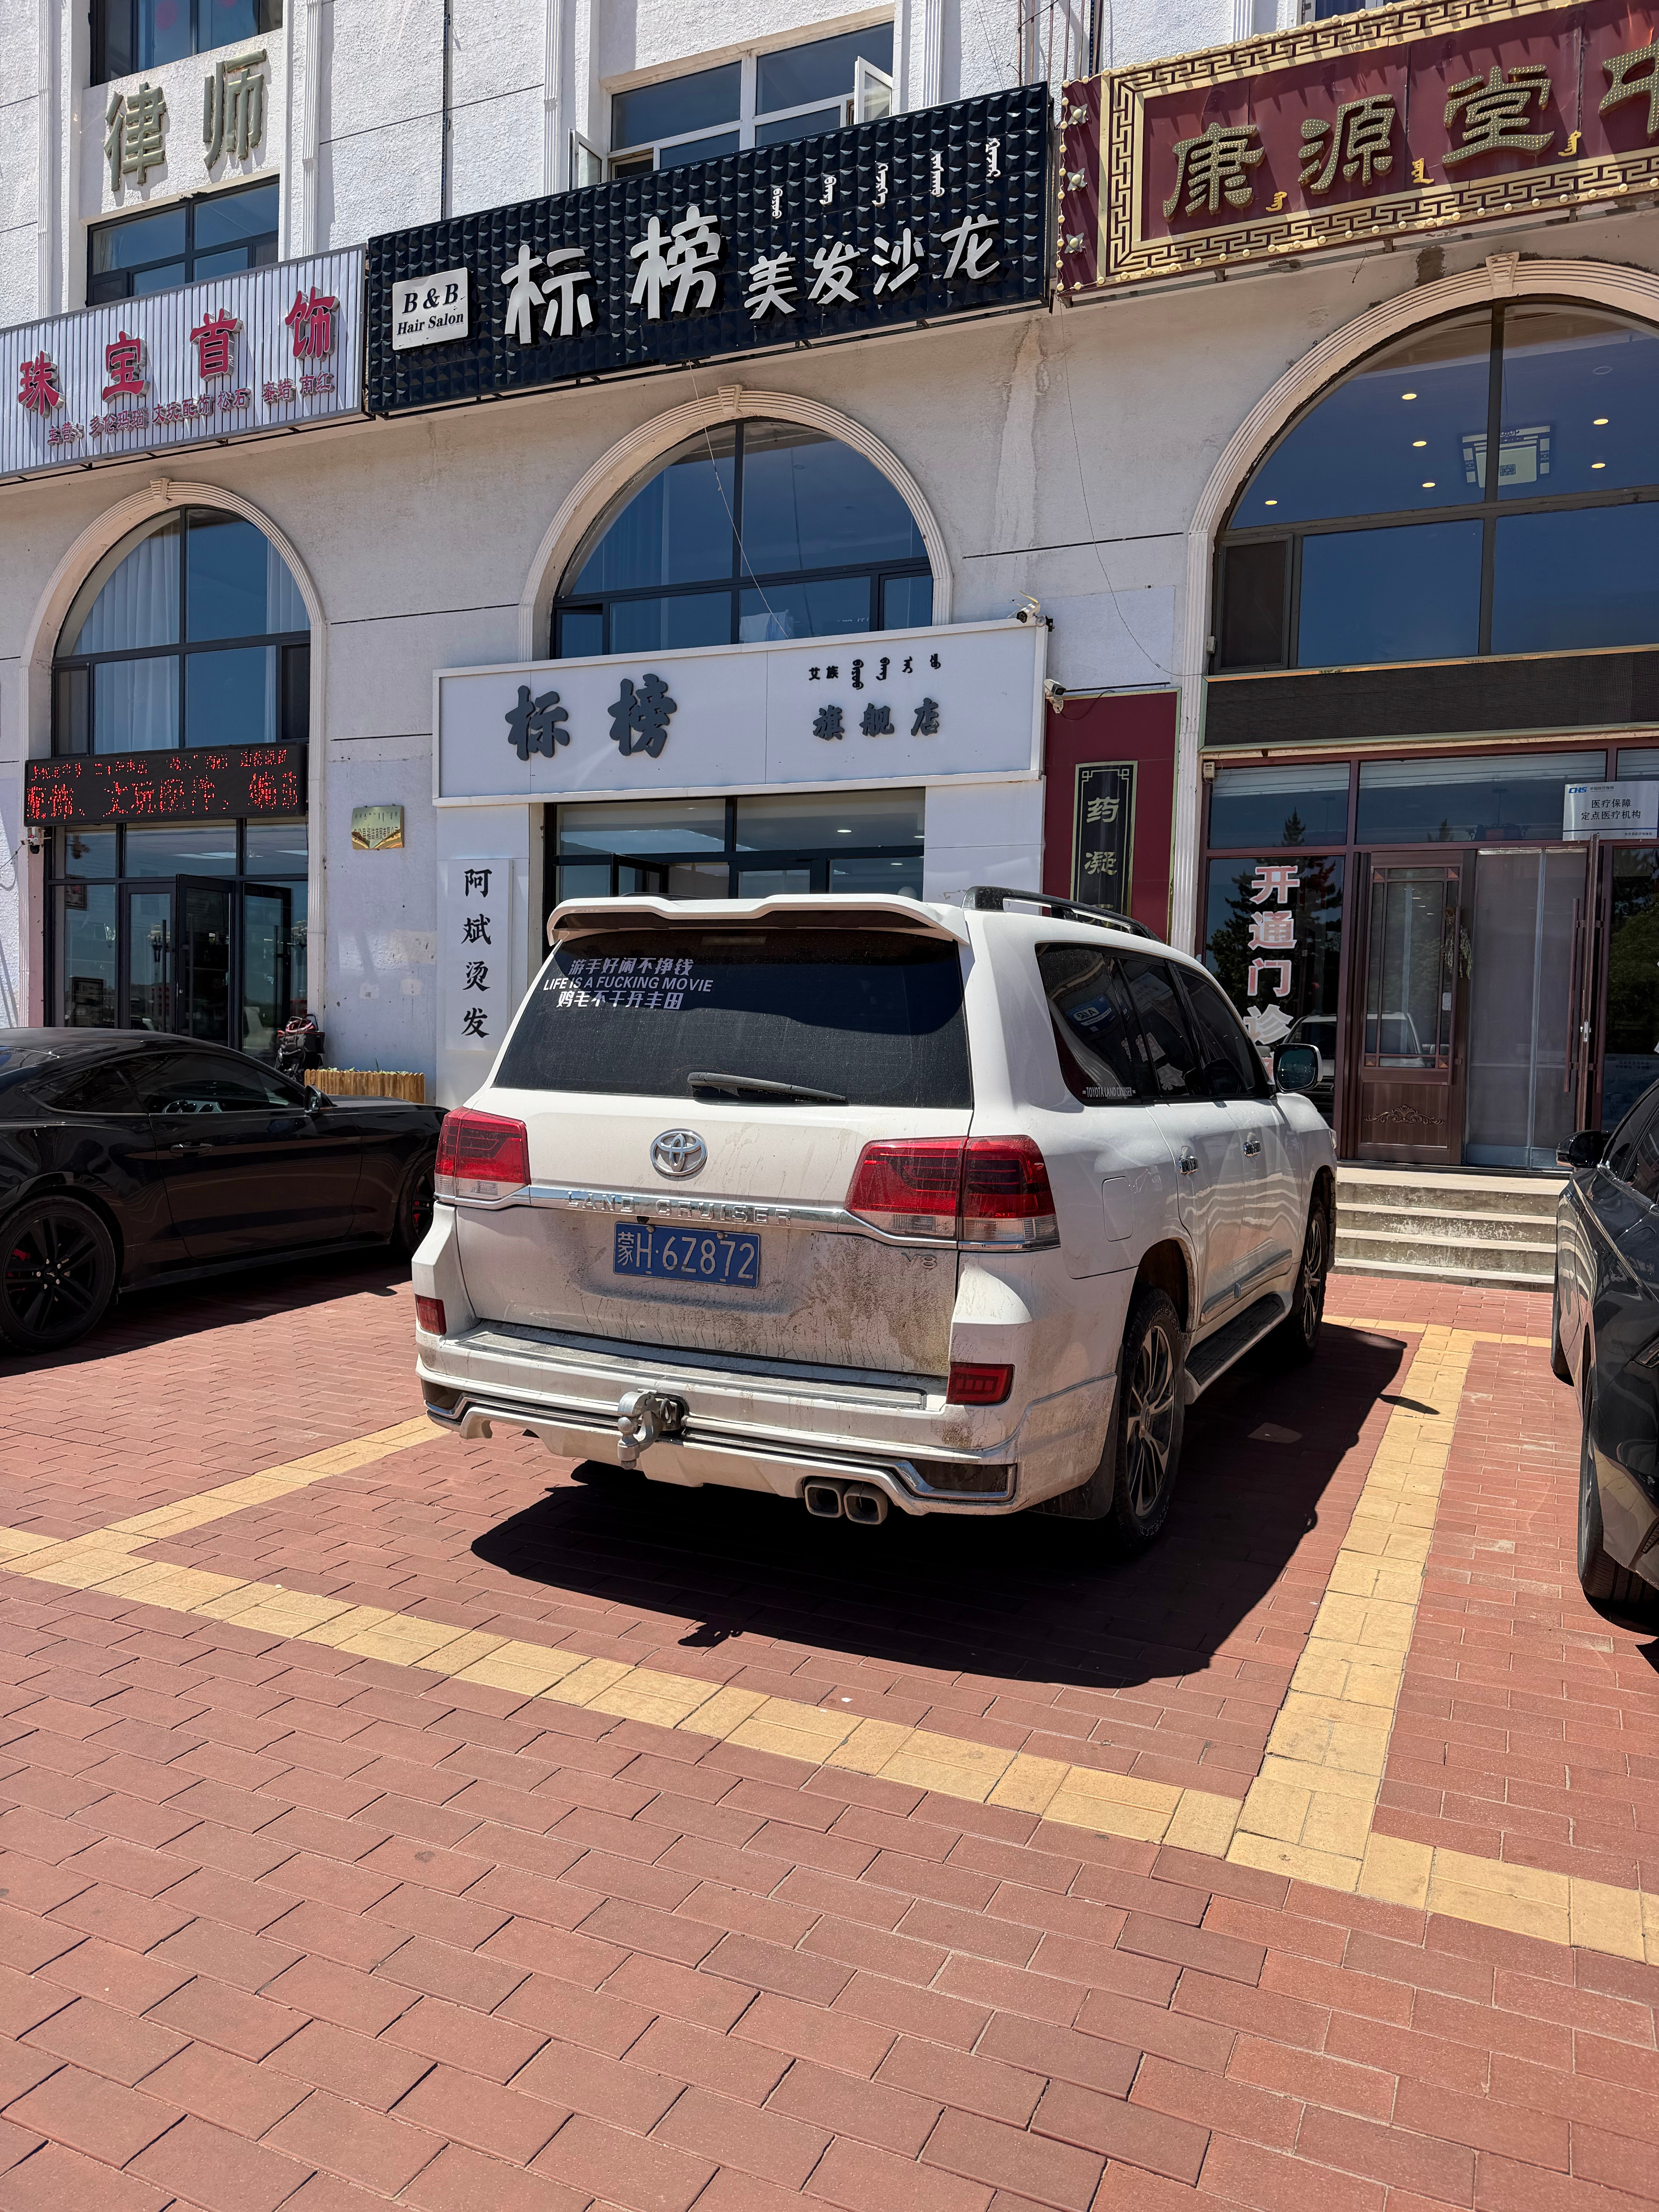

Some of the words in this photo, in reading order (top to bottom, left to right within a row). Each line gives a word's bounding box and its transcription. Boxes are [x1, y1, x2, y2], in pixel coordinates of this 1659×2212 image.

[104, 48, 267, 192] 律师
[501, 206, 721, 344] 标榜
[744, 214, 1000, 320] 美发沙龙
[402, 292, 418, 314] B
[423, 288, 440, 309] &
[443, 283, 459, 306] B
[397, 319, 425, 335] Hair
[428, 313, 464, 329] Salon
[18, 285, 340, 418] 珠宝首饰
[89, 407, 149, 438] 多伦玛瑙
[217, 388, 251, 413] 松石
[261, 378, 296, 404] 蜜蜡
[299, 371, 335, 397] 南红
[808, 665, 839, 681] 艾族
[505, 673, 677, 761] 标榜
[813, 697, 940, 741] 旗舰店
[1581, 810, 1641, 821] 定点医疗机构
[1591, 799, 1632, 809] 医疗保障
[461, 868, 493, 1039] 阿斌烫发
[568, 957, 694, 975] 游手好闲不挣钱
[543, 977, 568, 991] LIFE
[569, 977, 581, 989] IS
[584, 976, 593, 988] A
[596, 976, 659, 989] FUCKING
[661, 977, 714, 992] MOVIE
[556, 990, 684, 1010] 鸡毛不干开丰田
[1086, 1087, 1104, 1098] TOYOTA
[1104, 1087, 1116, 1098] LAND
[567, 1191, 635, 1213] LAND
[655, 1199, 792, 1226] CRUISER
[901, 1252, 938, 1270] V8
